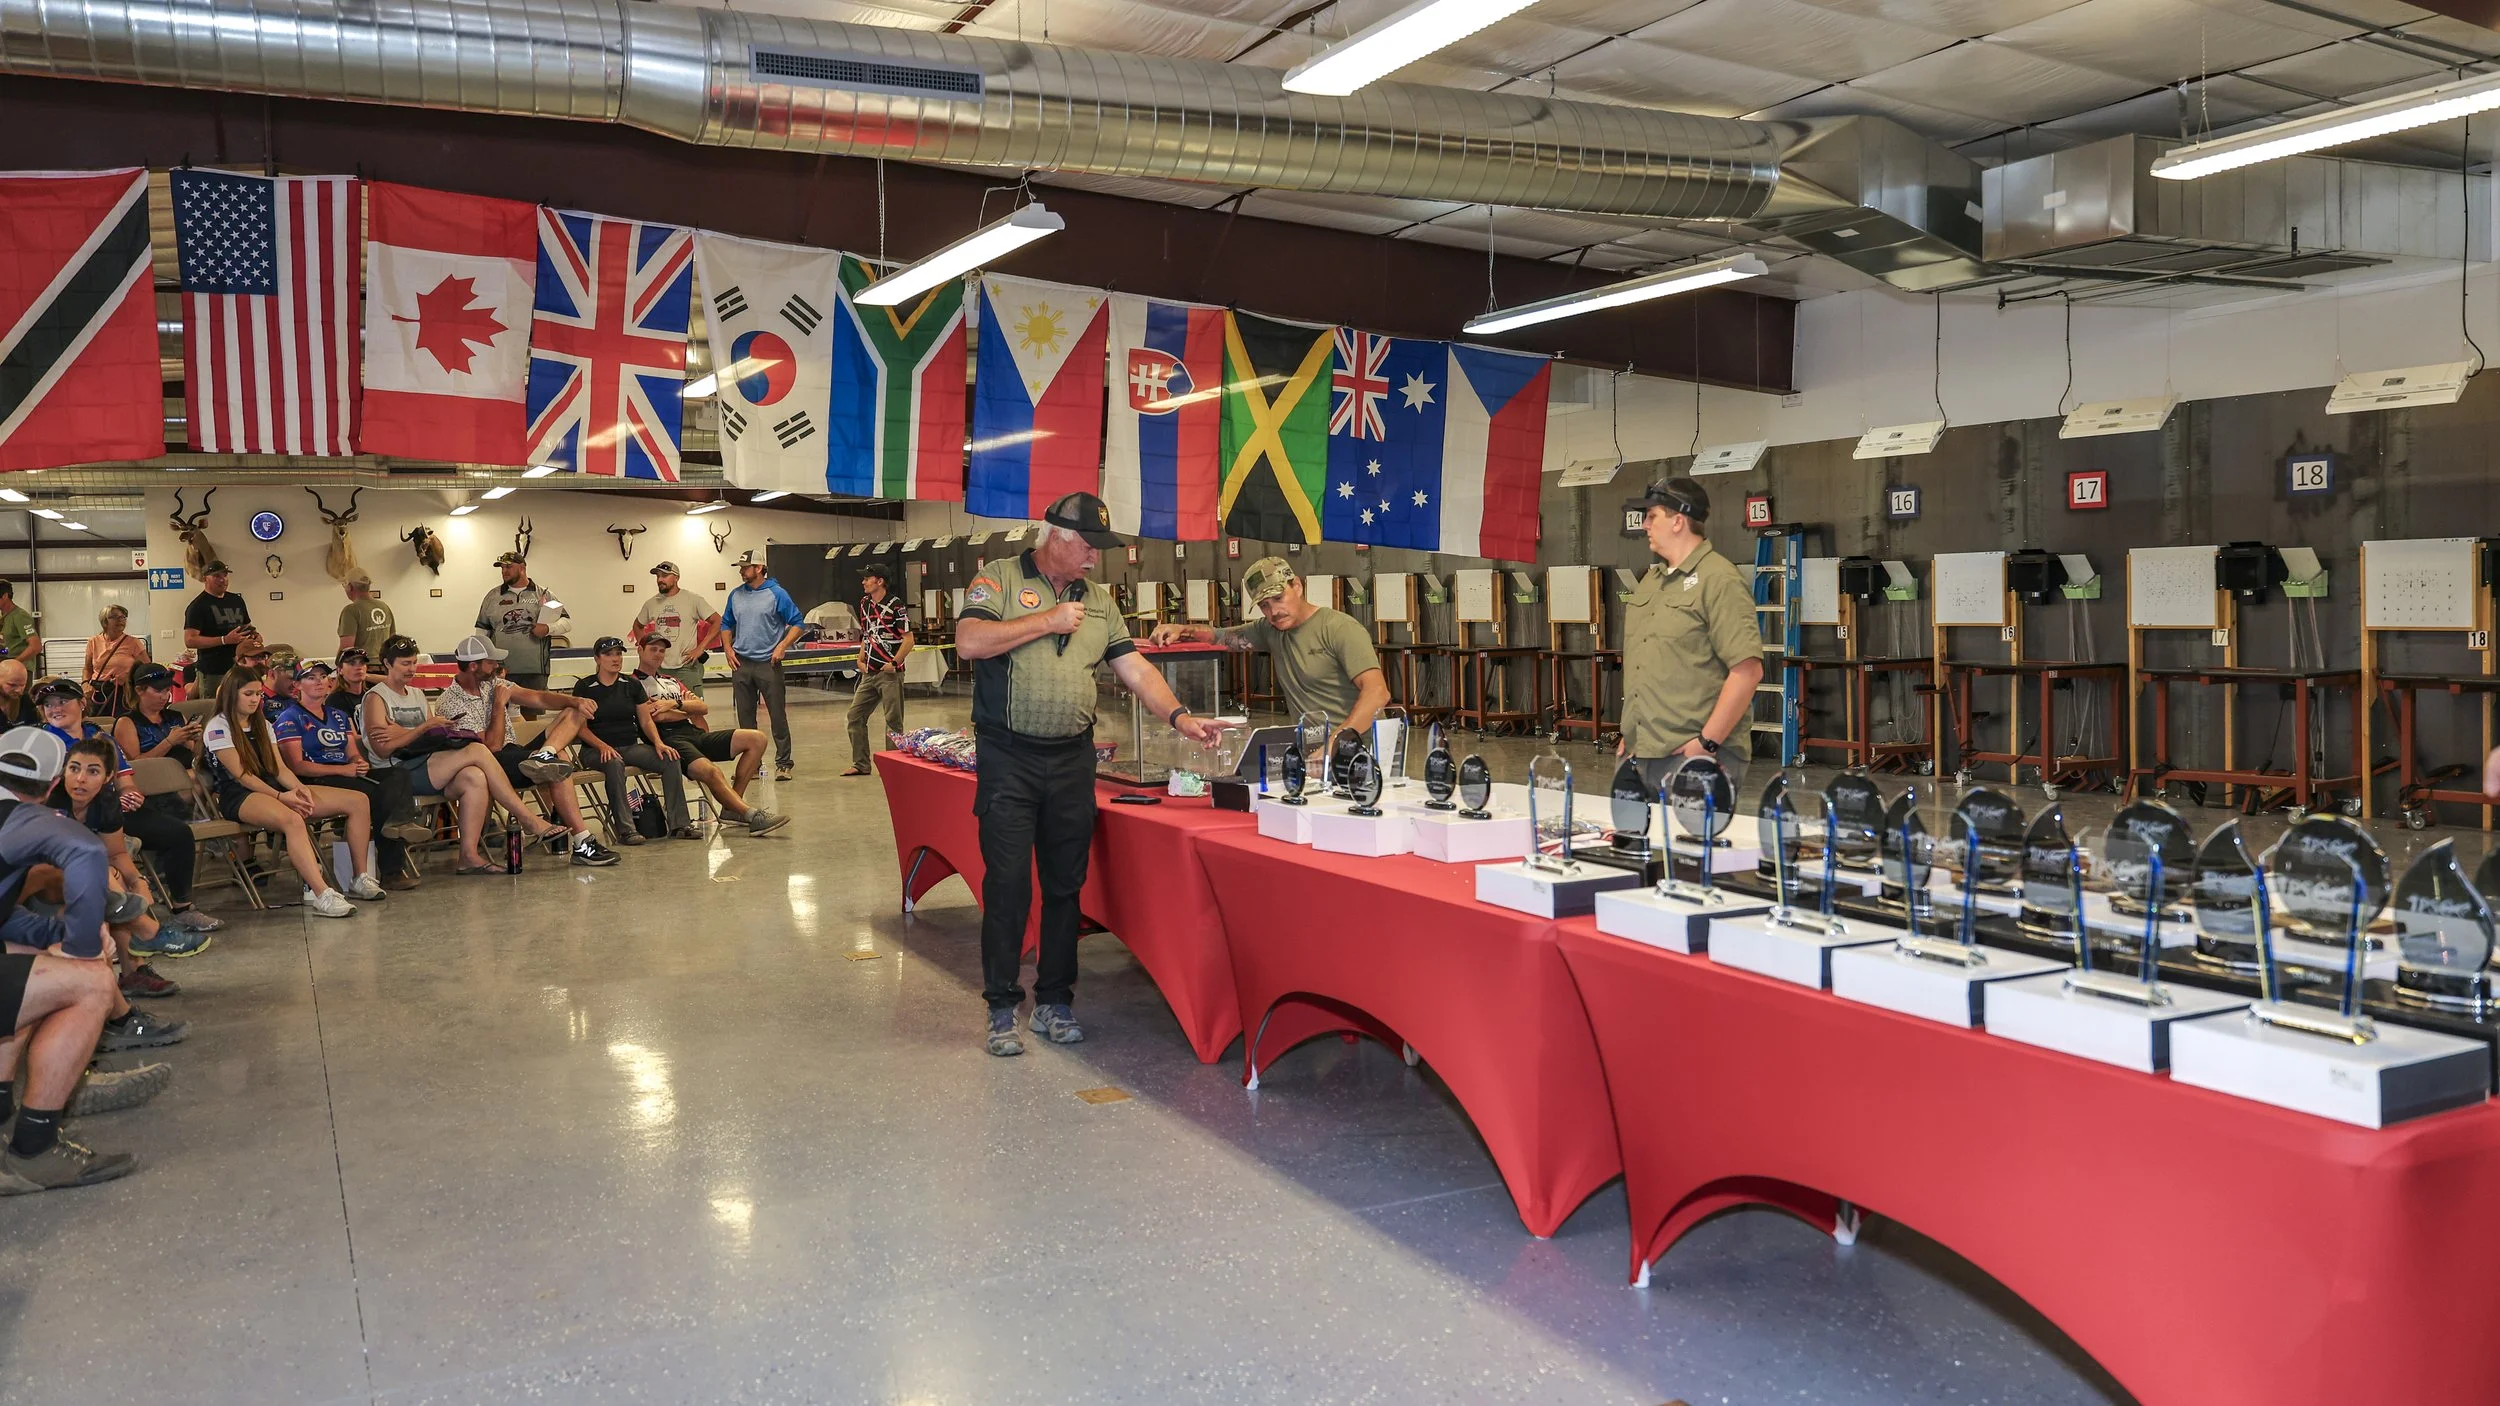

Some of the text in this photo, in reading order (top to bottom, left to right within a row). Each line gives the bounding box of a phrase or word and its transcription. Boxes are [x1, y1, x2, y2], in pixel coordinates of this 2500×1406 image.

[2296, 464, 2324, 487] 18
[2076, 480, 2099, 500] 17
[1894, 493, 1913, 511] 16
[1751, 503, 1767, 520] 15
[1628, 512, 1641, 528] 14
[1177, 545, 1183, 556] 8
[1231, 542, 1237, 553] 9
[1838, 625, 1847, 638] 15
[2003, 626, 2014, 640] 16
[2214, 629, 2227, 644] 17
[2471, 631, 2487, 647] 18
[317, 728, 346, 747] COLT
